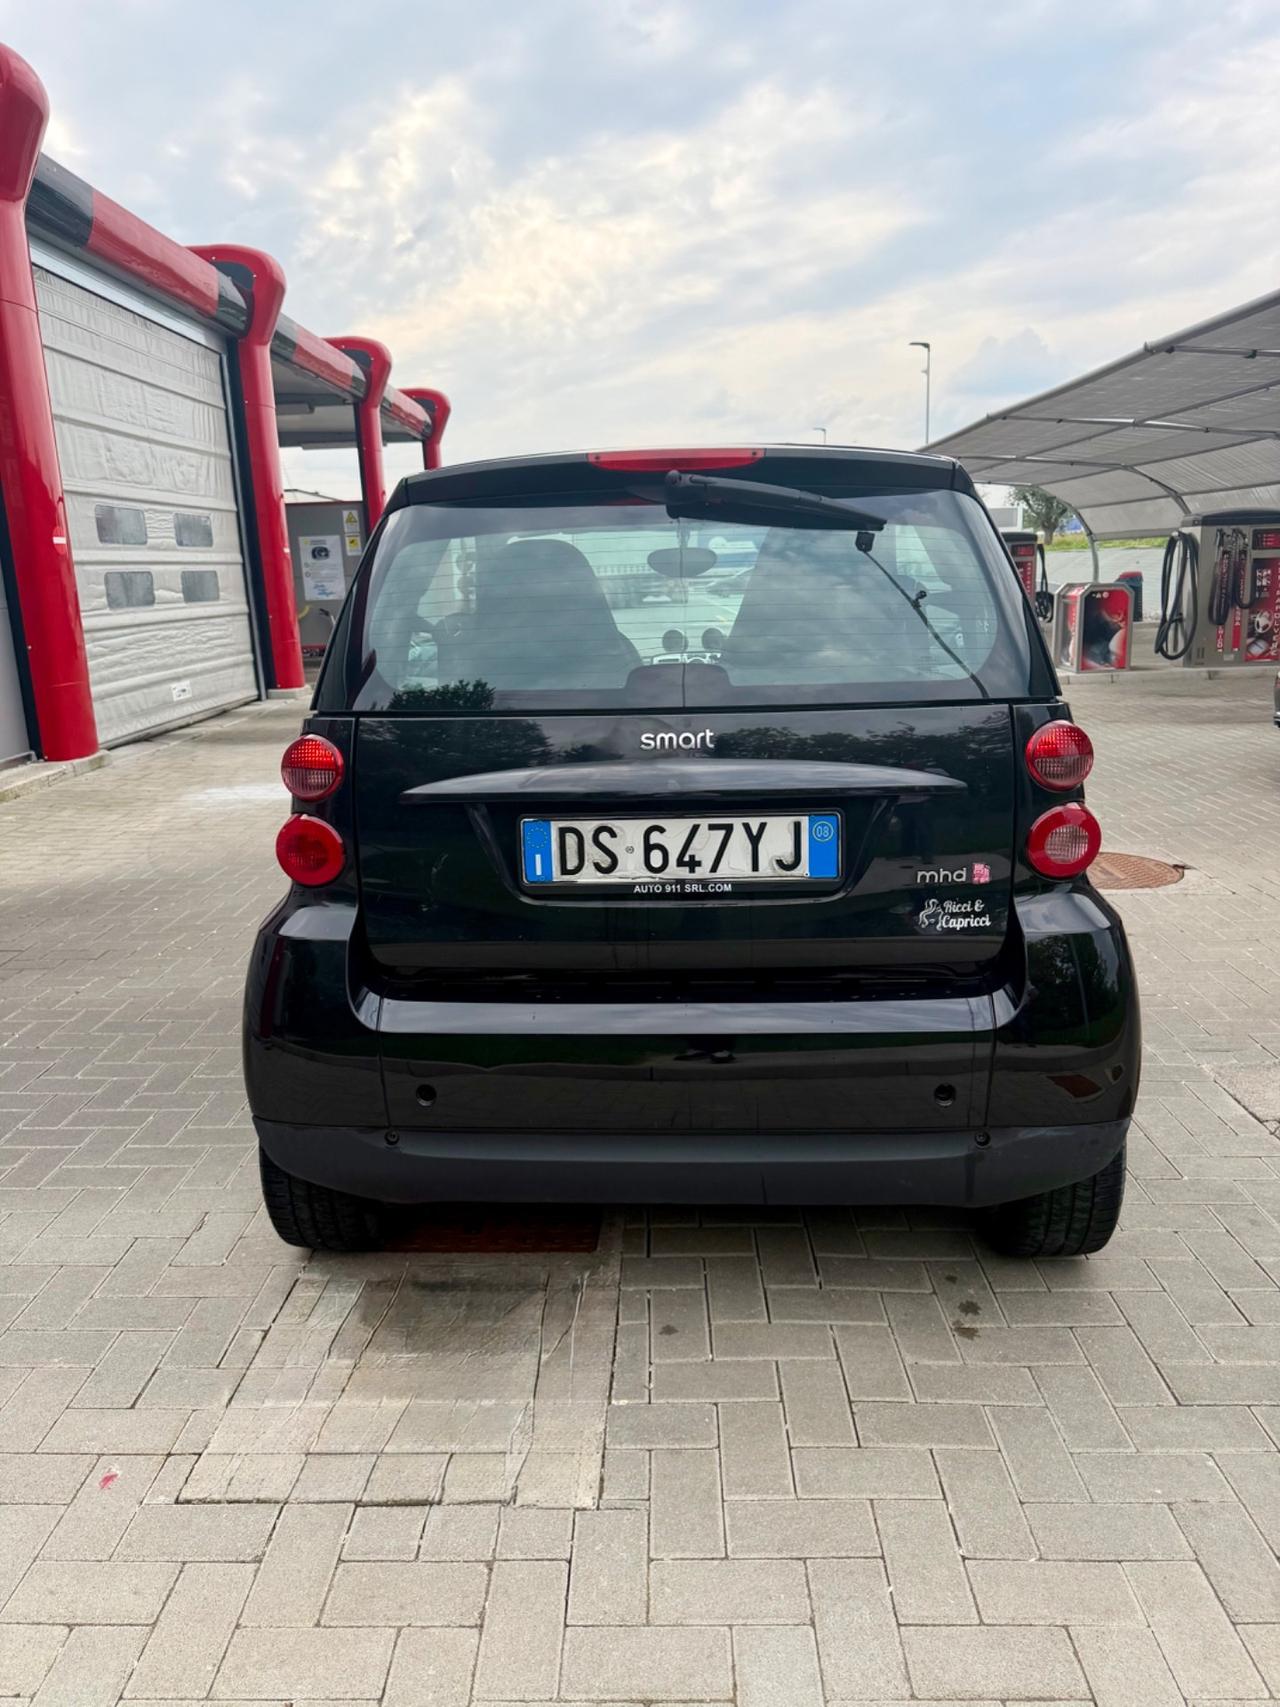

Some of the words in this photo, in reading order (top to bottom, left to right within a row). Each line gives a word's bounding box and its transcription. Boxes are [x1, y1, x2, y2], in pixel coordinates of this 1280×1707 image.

[640, 728, 715, 750] smart
[817, 825, 829, 837] 08
[557, 825, 619, 876] DS
[643, 821, 802, 875] 647YJ
[917, 867, 967, 883] mhd
[633, 884, 662, 893] AUTO
[665, 884, 681, 893] 911
[684, 883, 732, 893] SRL.COM
[943, 899, 972, 913] Ricci
[974, 899, 985, 912] &
[942, 914, 991, 930] Capricci
